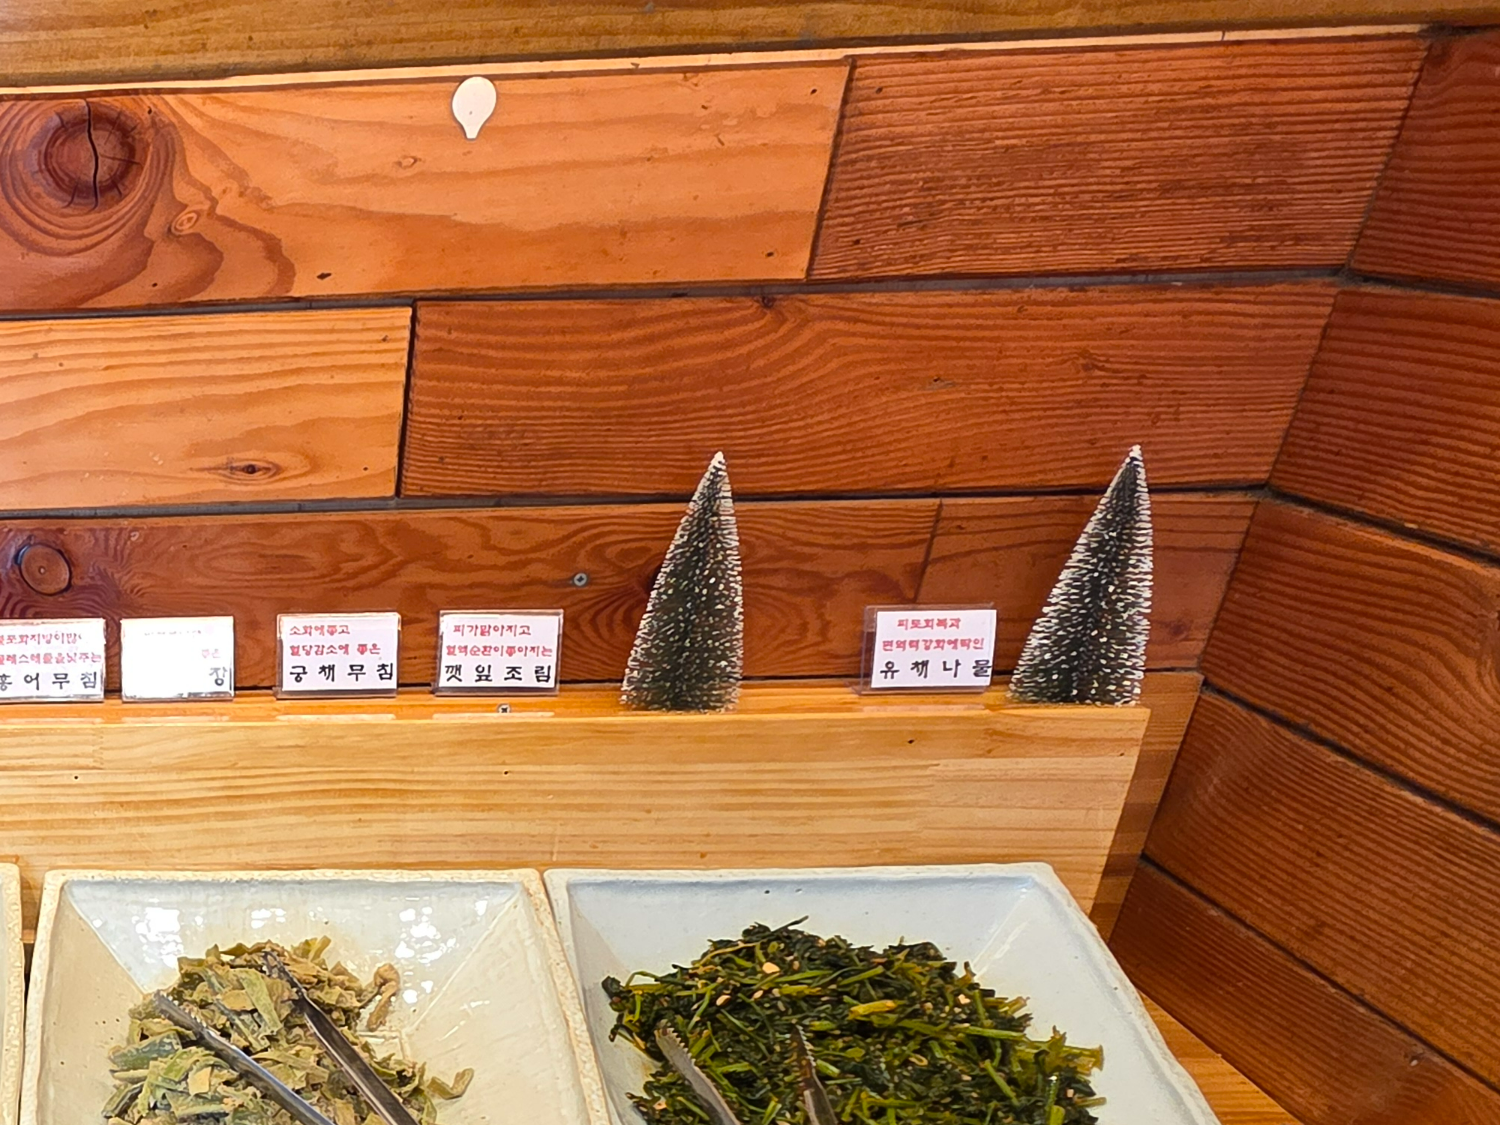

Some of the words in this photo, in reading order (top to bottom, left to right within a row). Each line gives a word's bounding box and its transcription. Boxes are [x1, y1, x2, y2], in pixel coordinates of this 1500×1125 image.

[289, 624, 350, 637] 소화에좋고
[453, 623, 532, 637] 피가맑아지고
[897, 617, 962, 631] 피로회복과
[357, 642, 381, 656] 좋은
